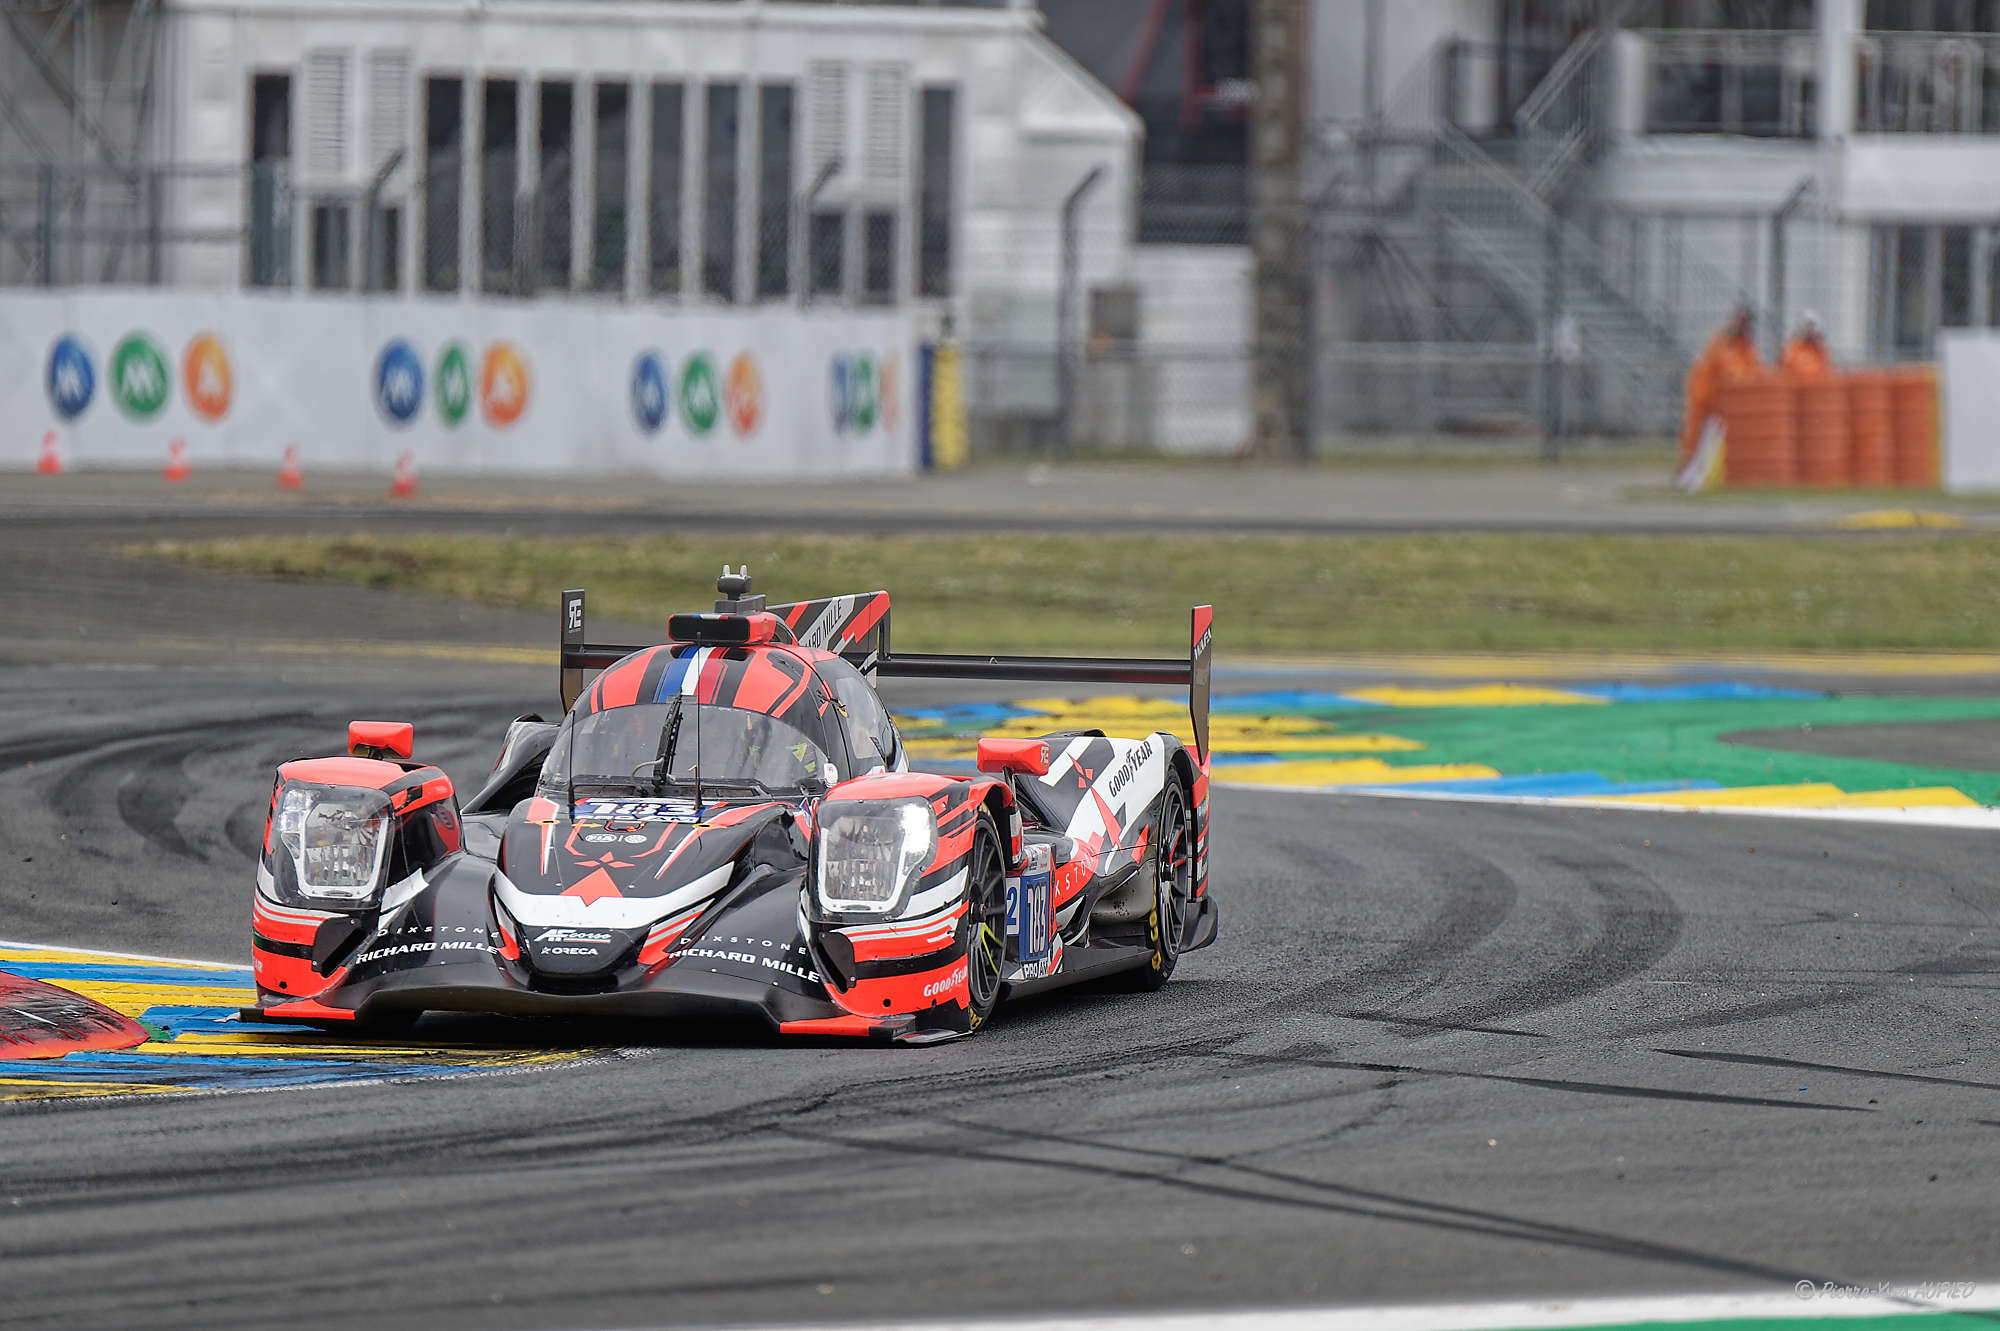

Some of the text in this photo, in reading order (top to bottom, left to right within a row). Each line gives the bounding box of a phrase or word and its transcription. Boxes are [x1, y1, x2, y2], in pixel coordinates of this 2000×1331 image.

[376, 926, 500, 938] DIXSTONE
[355, 941, 498, 965] RICHARD MILLE
[551, 946, 599, 956] ORECA
[680, 935, 807, 955] DIXSTONE
[669, 948, 821, 984] RICHARD MILLE
